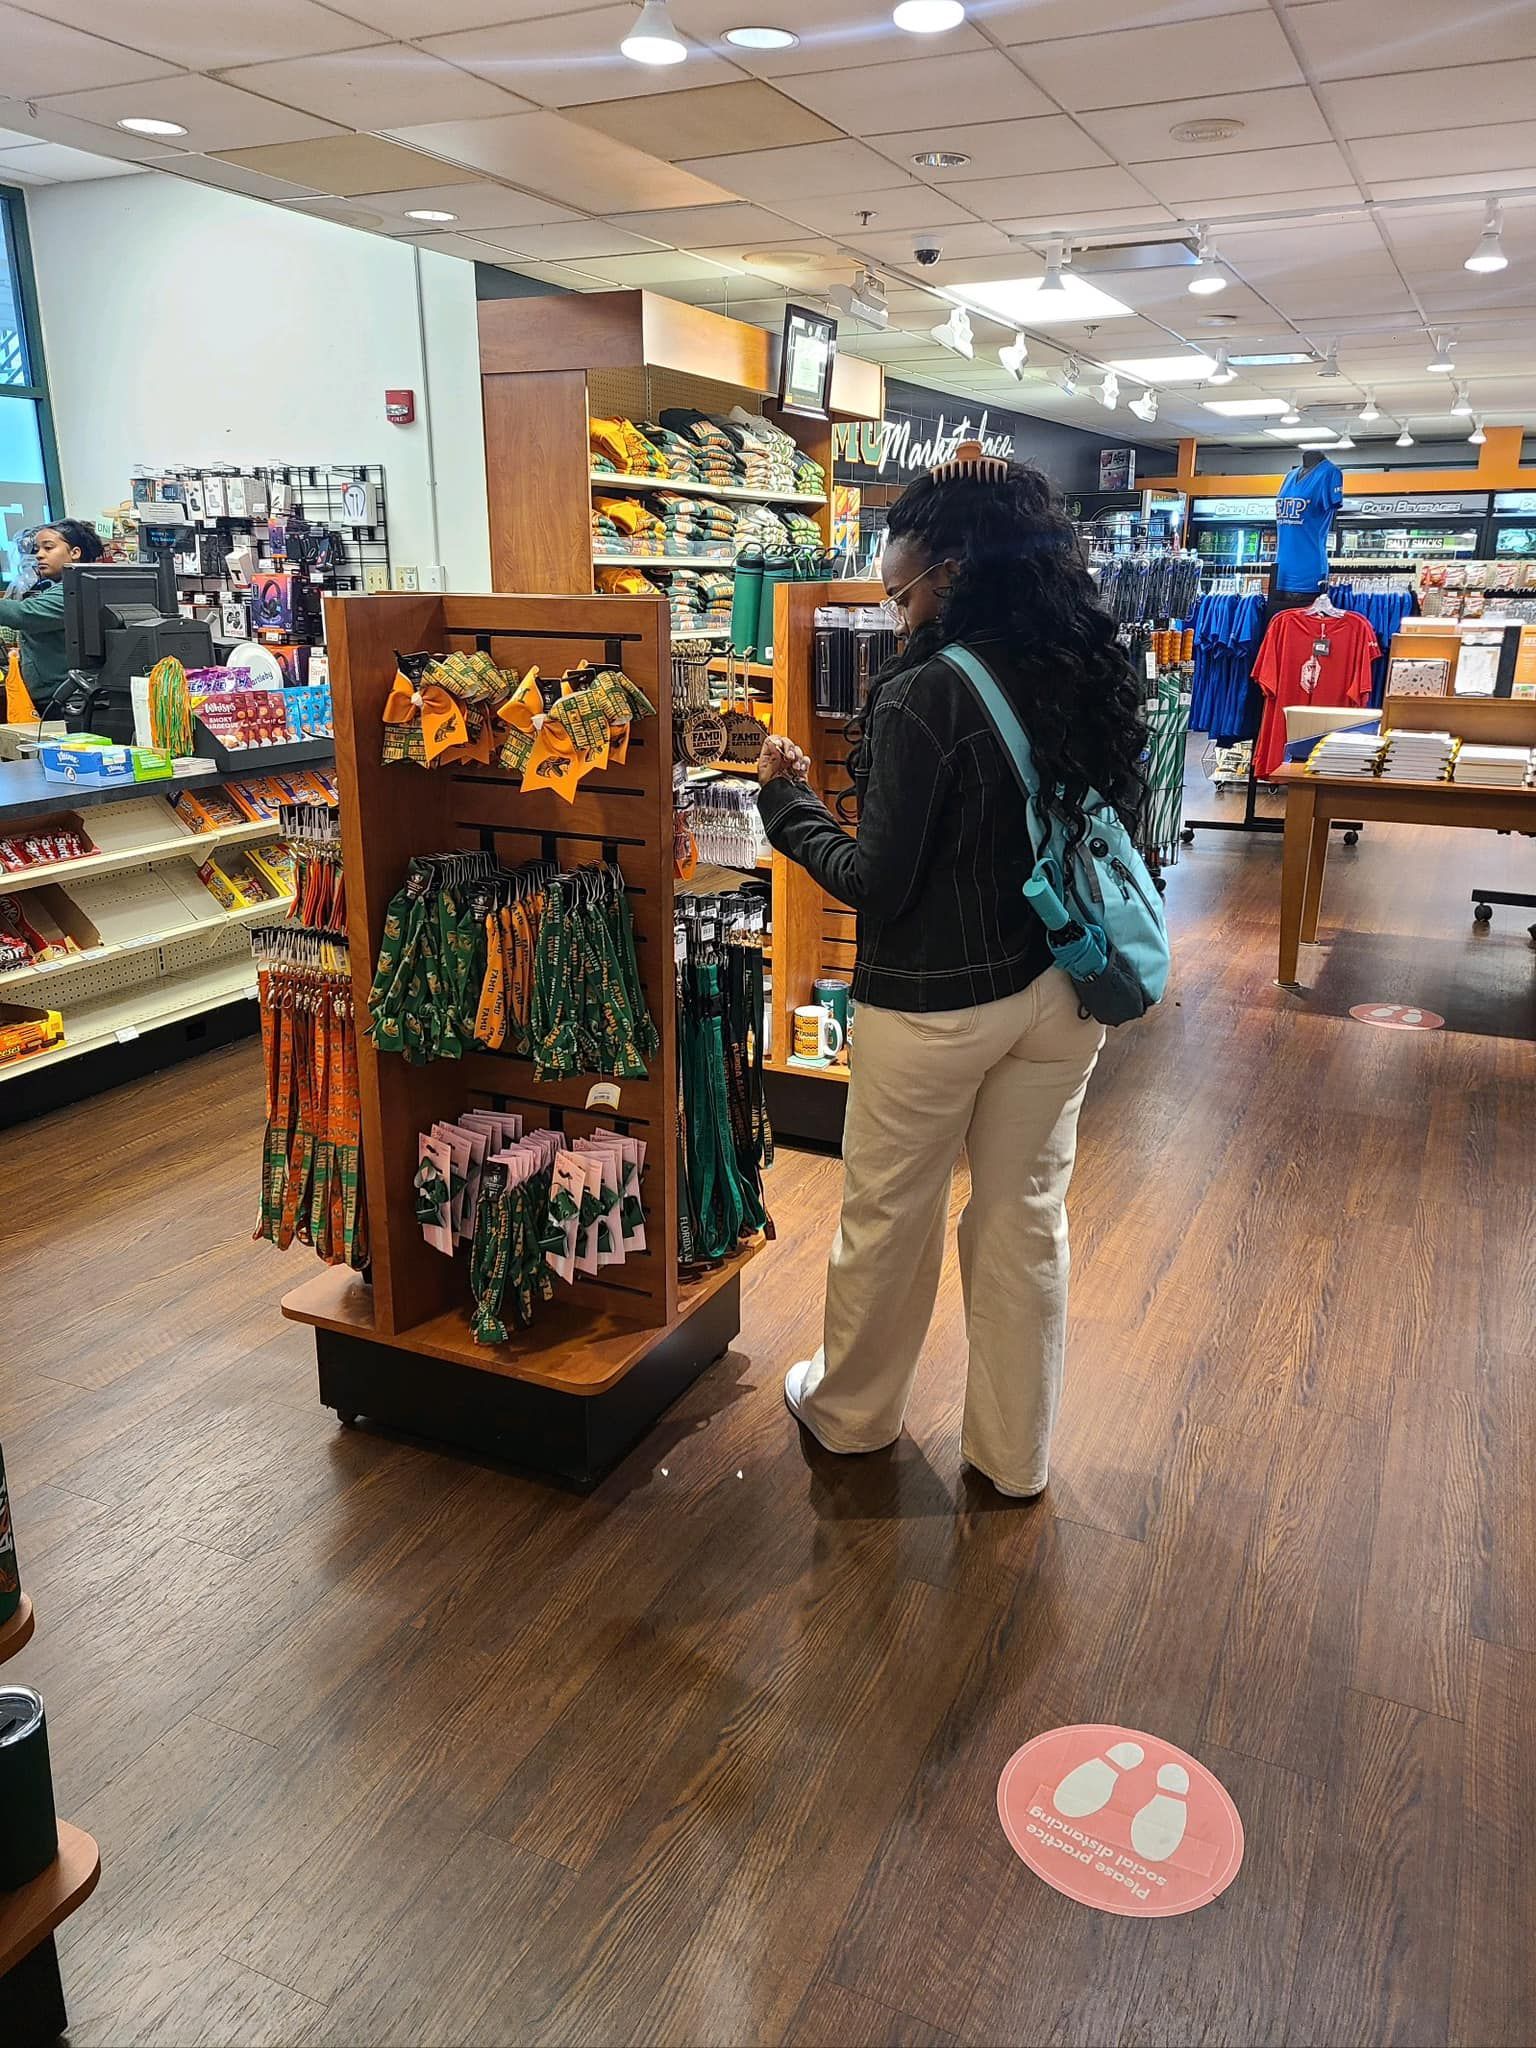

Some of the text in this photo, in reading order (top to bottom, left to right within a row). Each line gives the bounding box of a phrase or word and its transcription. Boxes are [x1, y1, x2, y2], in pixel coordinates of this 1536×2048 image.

[876, 409, 1015, 475] Marketlace
[204, 702, 237, 714] Whisps
[692, 731, 720, 742] FAMU
[731, 732, 761, 742] FAMU
[487, 968, 499, 994] FAMU
[480, 1007, 490, 1031] FAMU
[678, 1216, 691, 1251] FLORIDA
[1028, 1805, 1168, 1887] social distancing
[1025, 1823, 1151, 1901] Please practice
